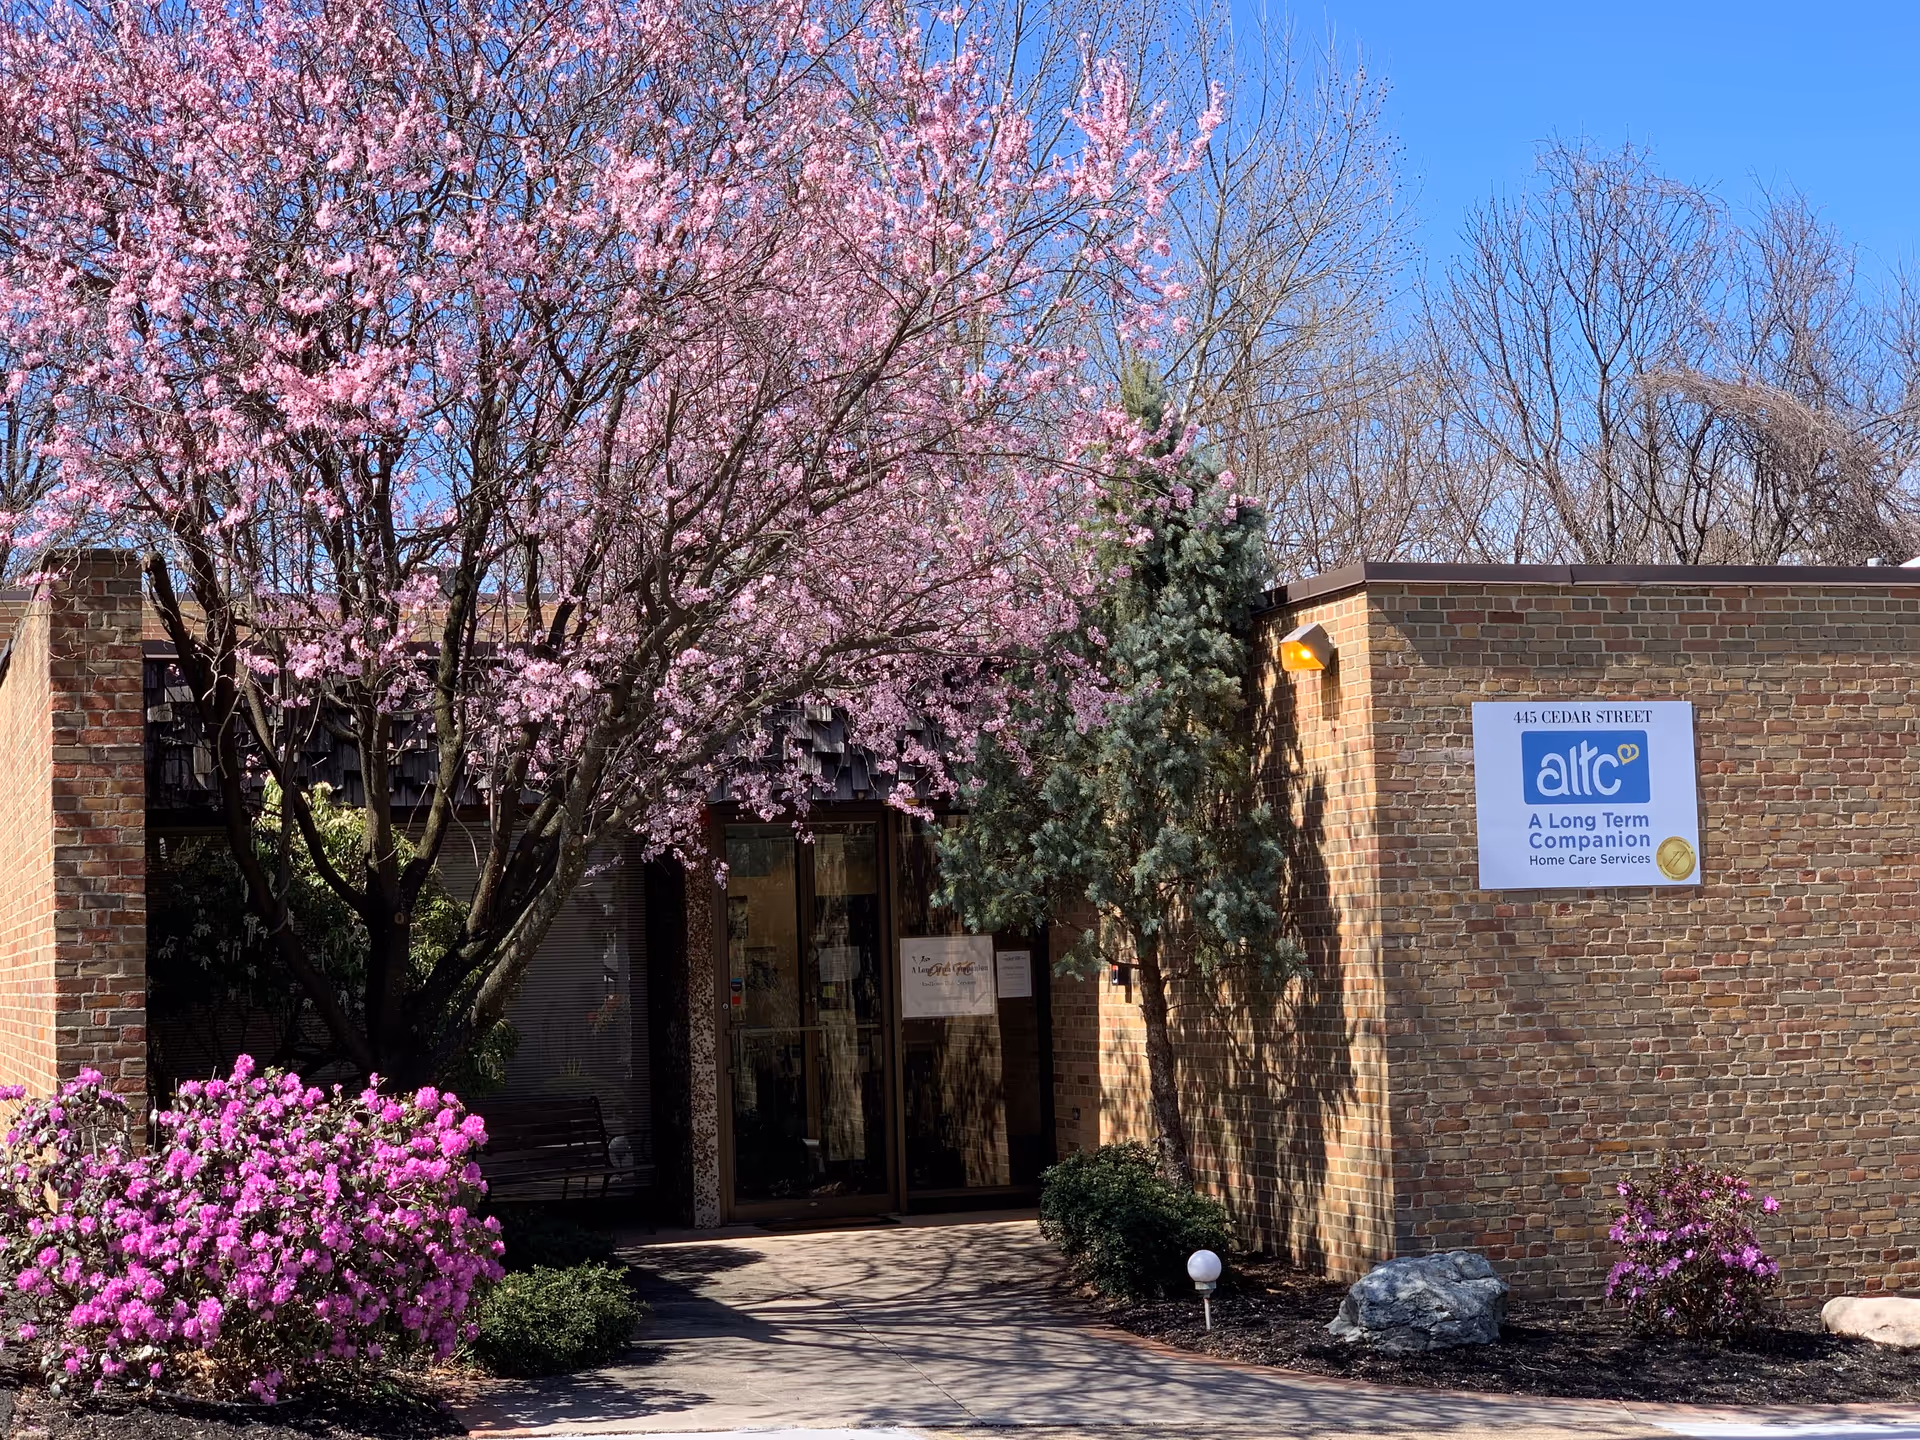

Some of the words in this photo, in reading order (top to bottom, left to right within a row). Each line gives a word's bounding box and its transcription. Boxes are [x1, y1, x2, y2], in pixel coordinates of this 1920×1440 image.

[1513, 711, 1537, 724] 445
[1541, 711, 1591, 724] CEDAR
[1596, 710, 1652, 724] STREET
[1537, 740, 1622, 796] altc
[1529, 814, 1542, 828] A
[1549, 813, 1596, 831] Long
[1603, 812, 1649, 828] Term
[1529, 831, 1650, 851] Companion
[1529, 855, 1564, 866] Home
[1569, 854, 1596, 865] Care
[1600, 853, 1651, 864] Services
